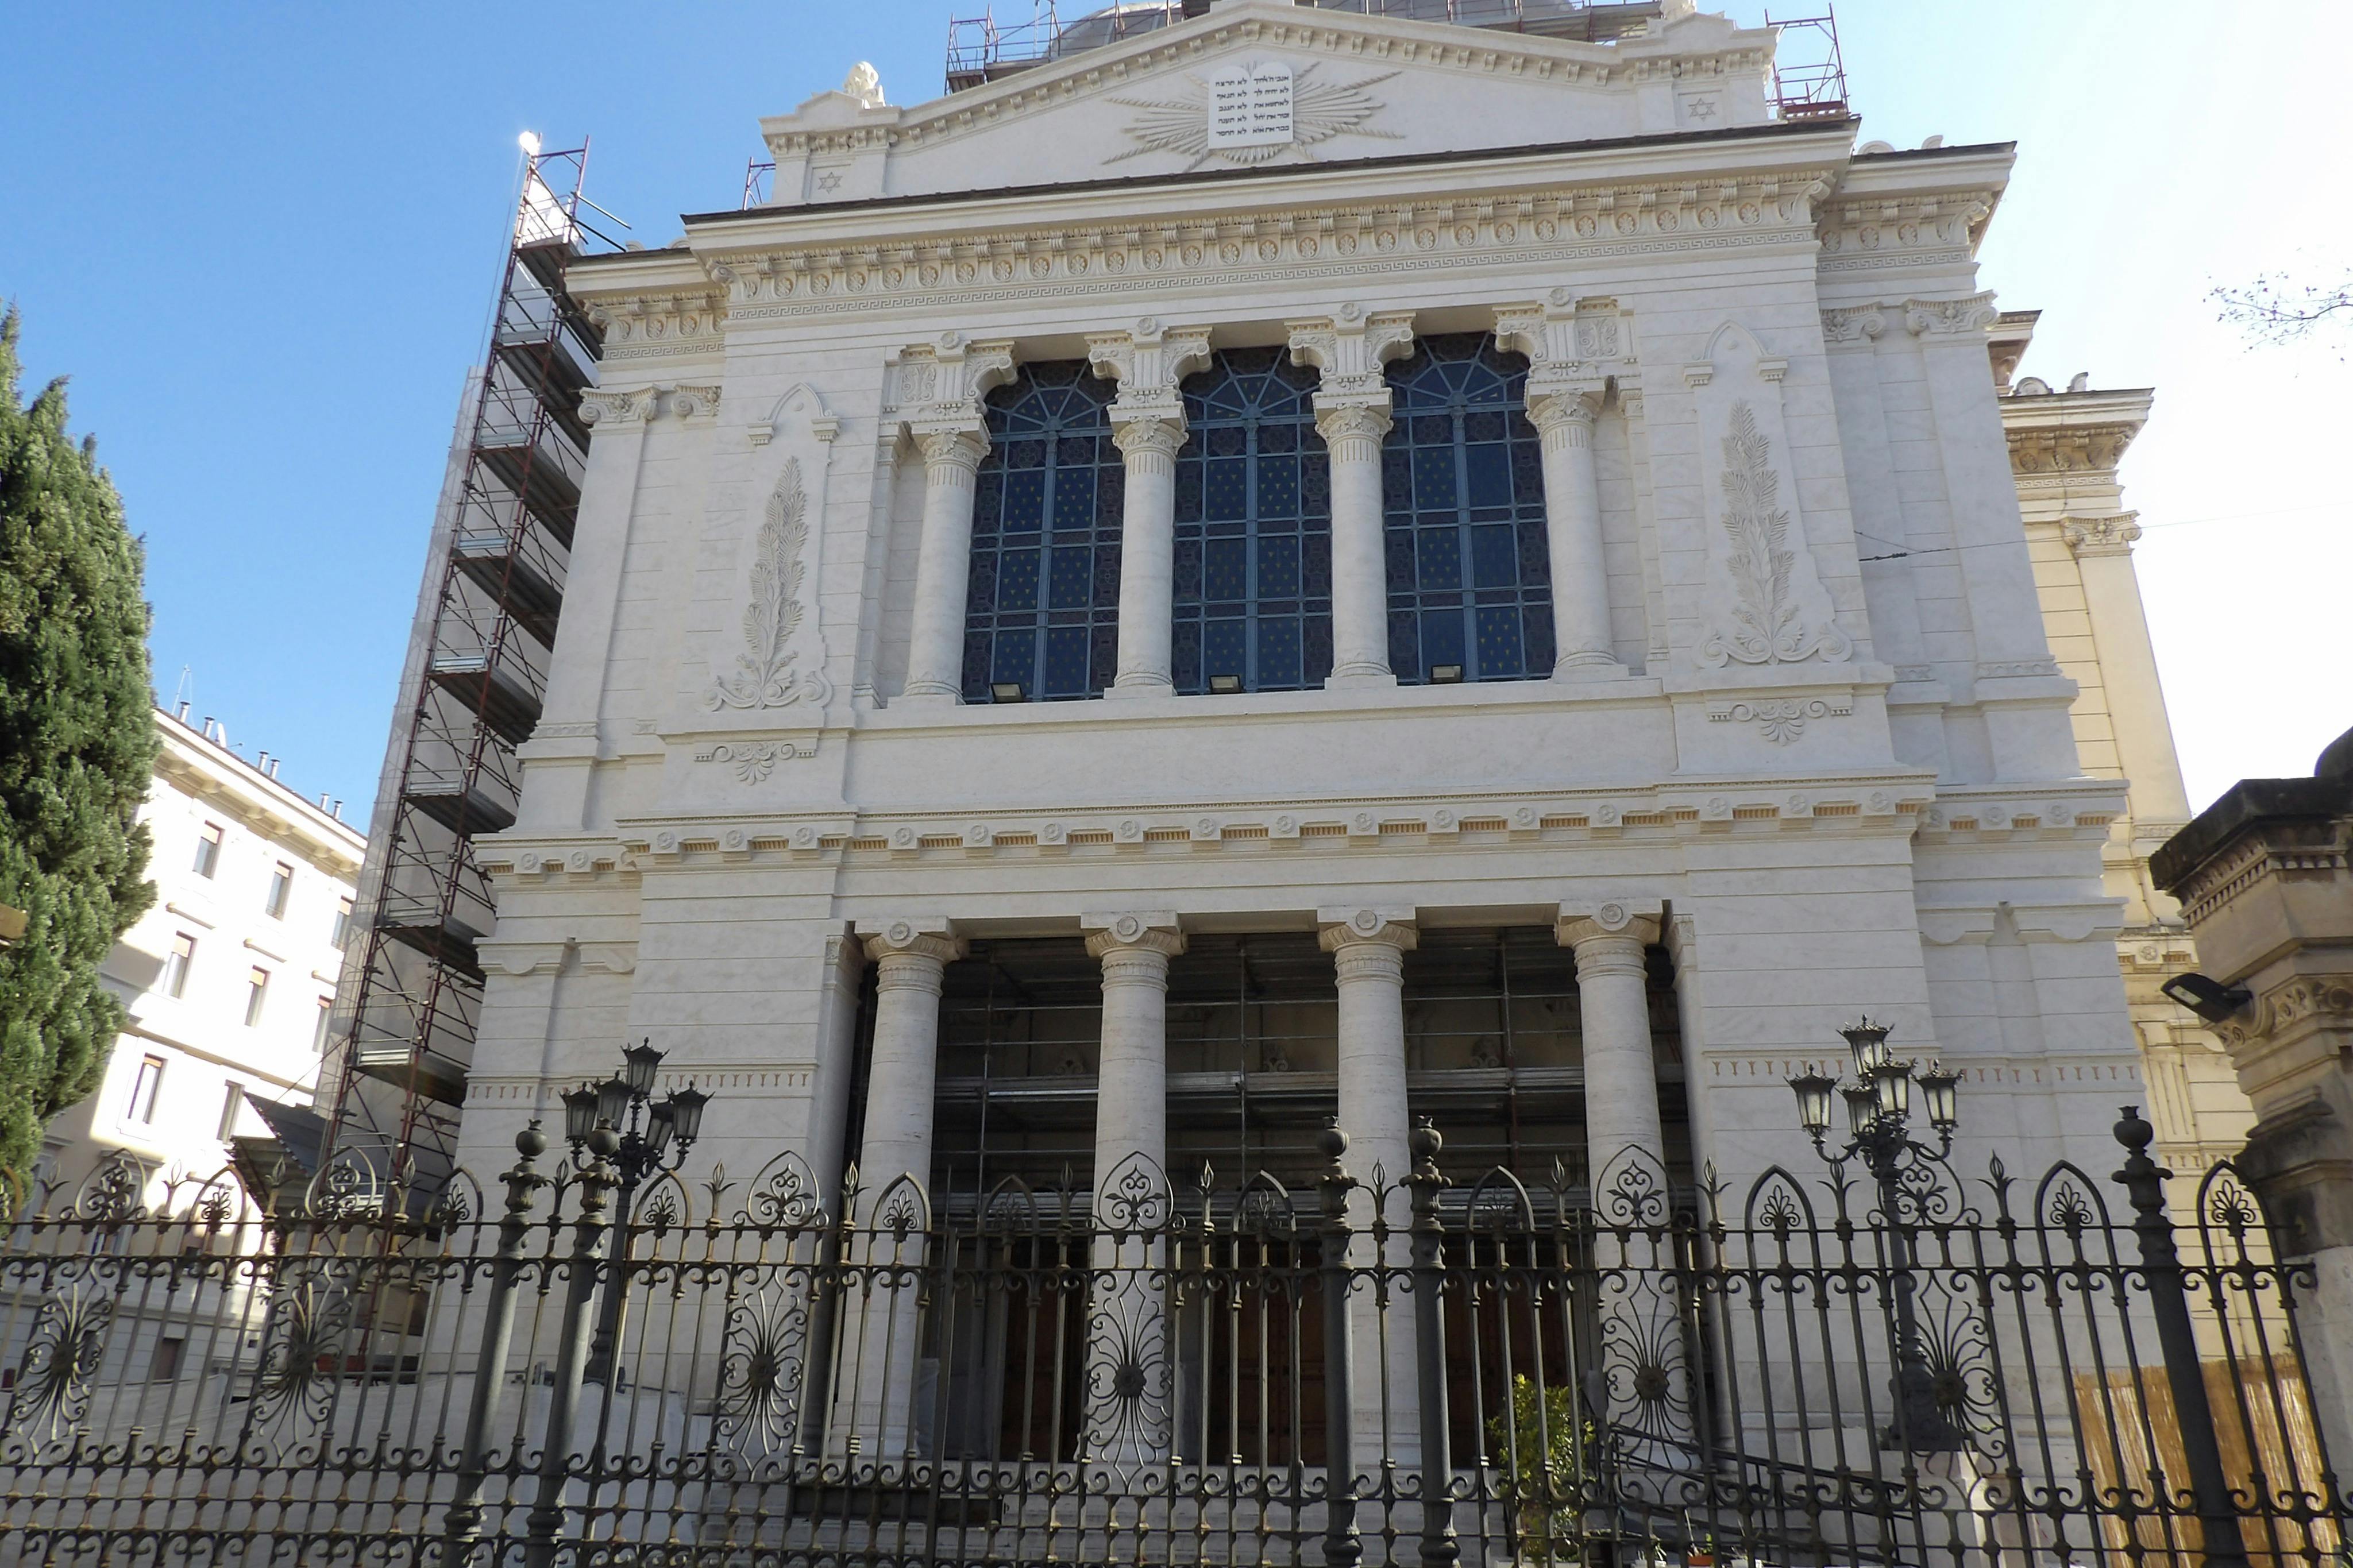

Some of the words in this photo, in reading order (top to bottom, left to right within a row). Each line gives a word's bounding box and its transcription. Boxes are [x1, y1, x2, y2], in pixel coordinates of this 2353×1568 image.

[1237, 77, 1247, 85] לא
[1254, 88, 1263, 96] לך
[1217, 92, 1235, 101] תנאף
[1237, 127, 1247, 135] לא
